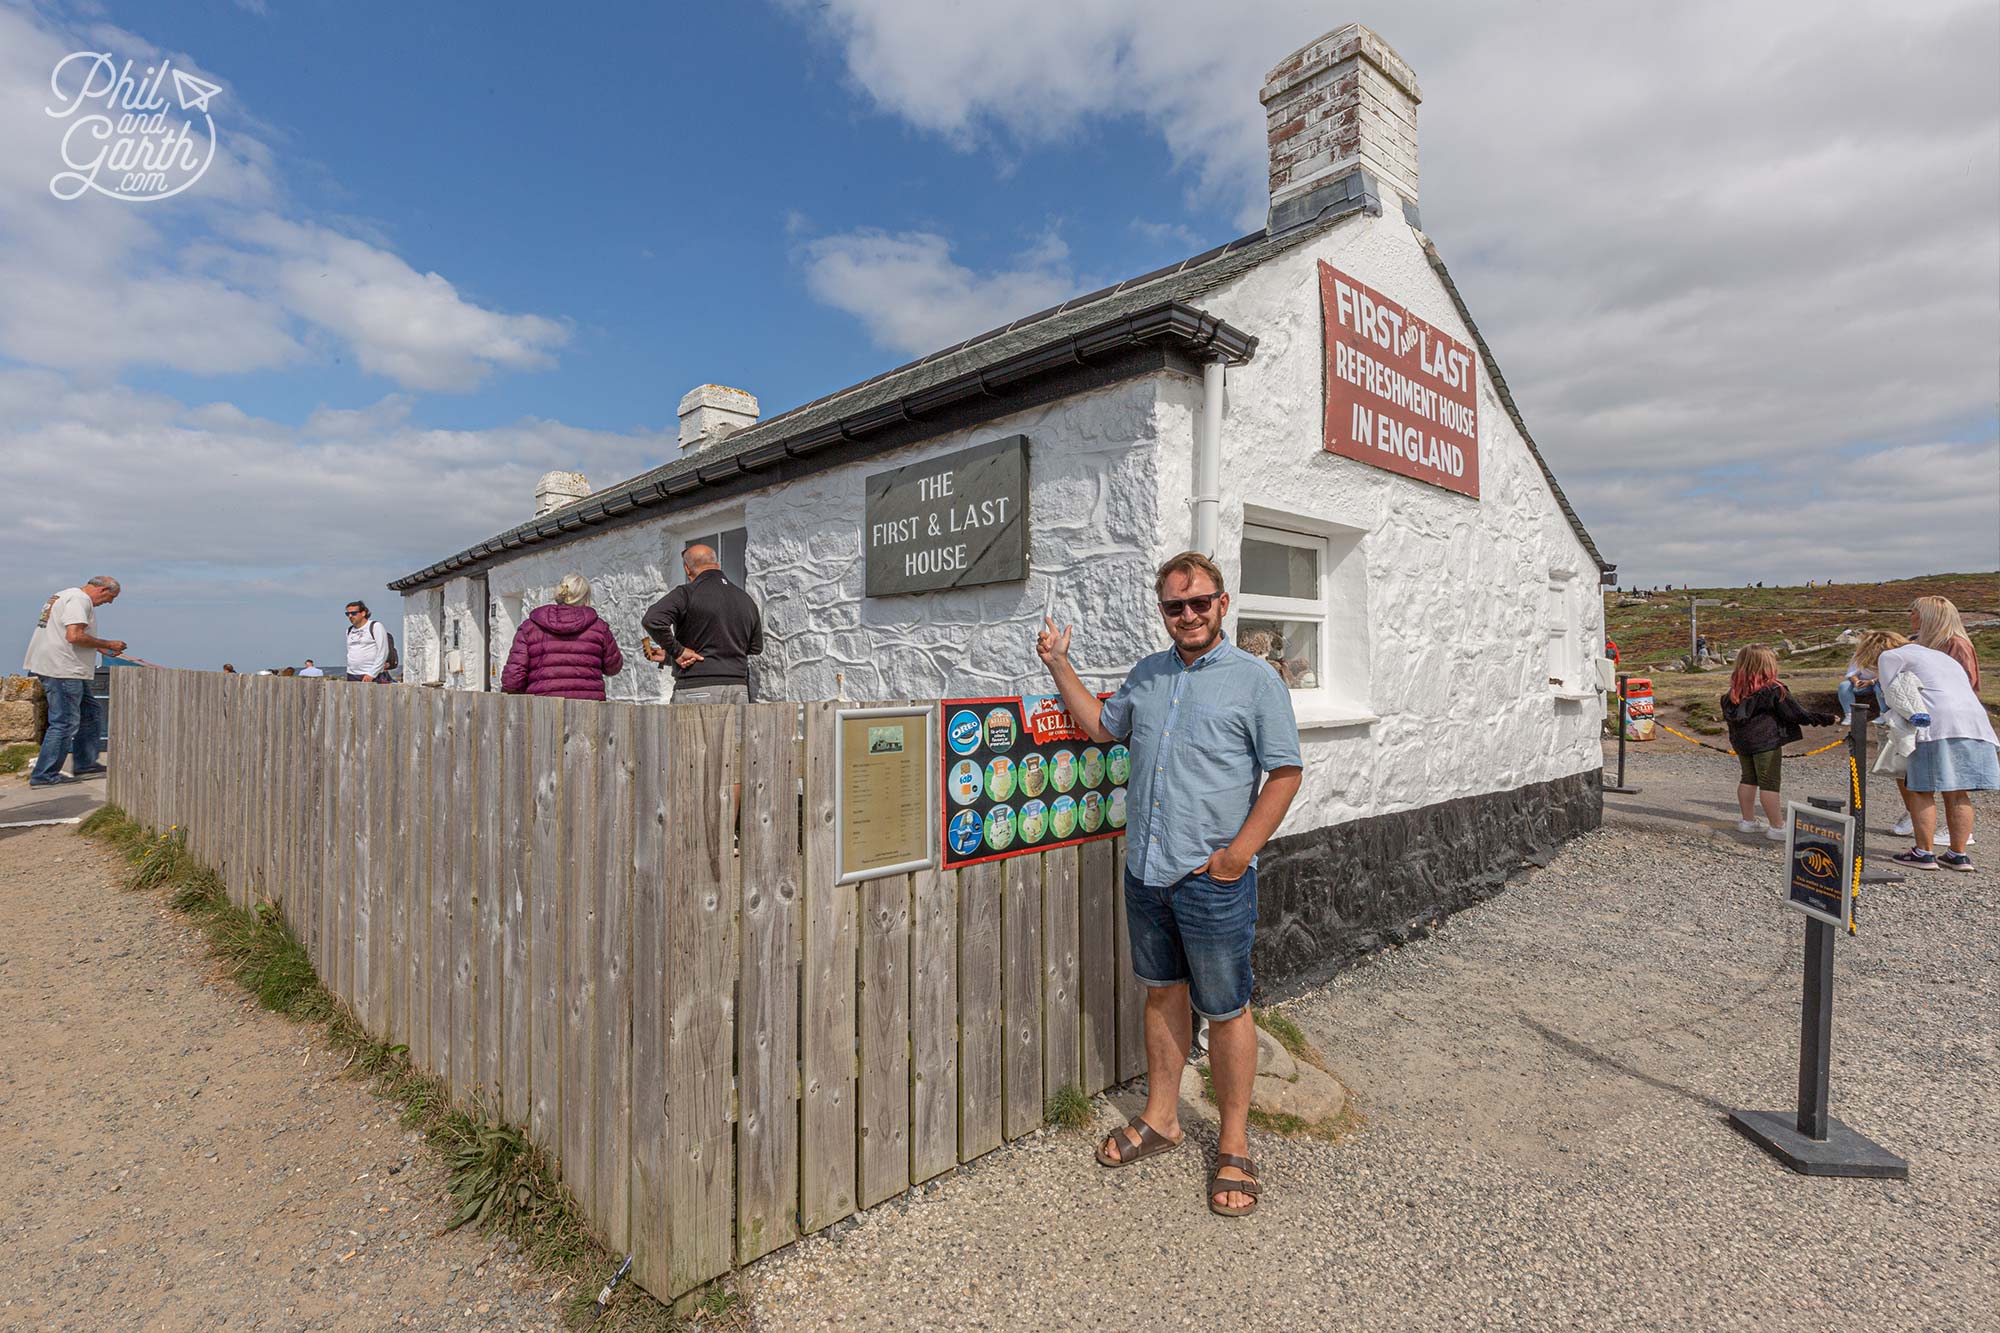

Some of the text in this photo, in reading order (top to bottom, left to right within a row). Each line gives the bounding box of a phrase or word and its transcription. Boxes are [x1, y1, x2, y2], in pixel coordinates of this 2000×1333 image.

[1334, 279, 1470, 392] FIRST AND LAST
[1336, 340, 1475, 439] REFRESHMENT HOUSE
[1352, 403, 1464, 478] IN ENGLAND
[918, 471, 954, 501] THE
[873, 497, 1009, 547] FIRST & LAST
[905, 544, 968, 577] HOUSE
[952, 721, 978, 739] OREO
[1036, 714, 1081, 733] KELLY
